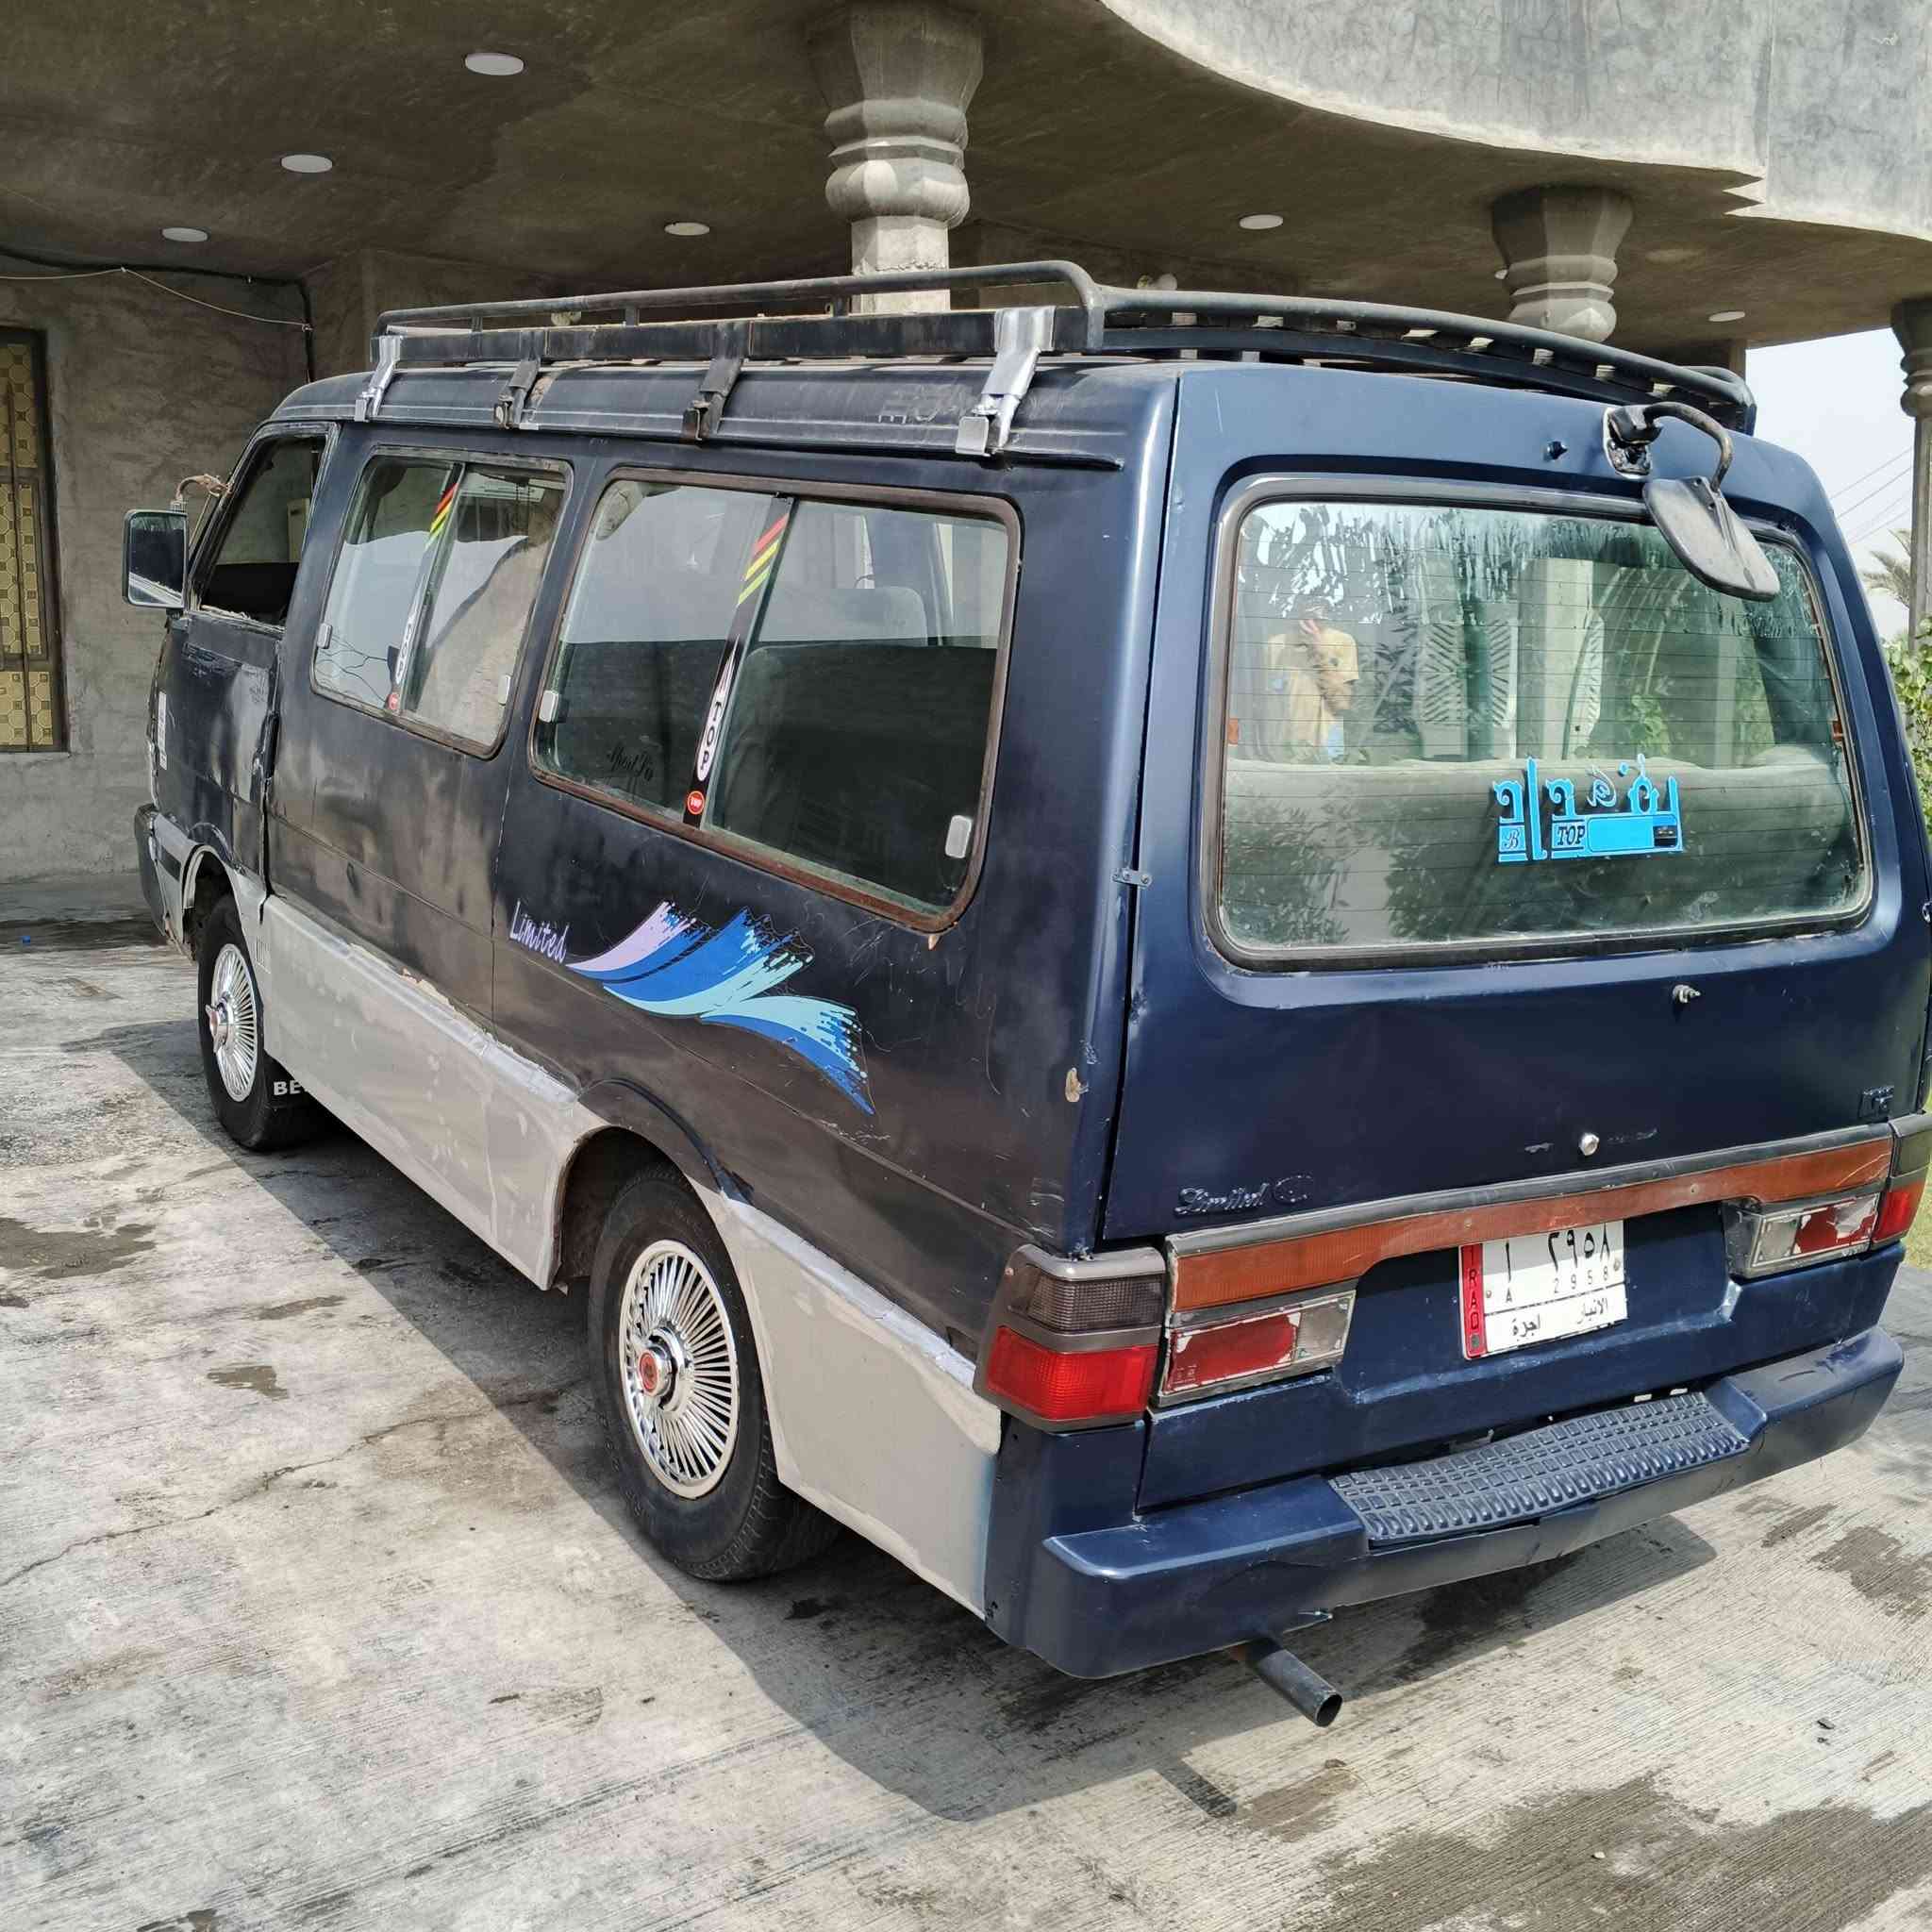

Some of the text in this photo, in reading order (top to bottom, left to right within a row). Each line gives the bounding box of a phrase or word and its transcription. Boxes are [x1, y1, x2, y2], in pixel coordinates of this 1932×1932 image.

[700, 701, 723, 772] TOP
[1557, 824, 1586, 845] TOP
[510, 898, 570, 963] Limited
[1548, 1222, 1610, 1272] ٢٩٥٨
[1506, 1266, 1608, 1304] A 2958
